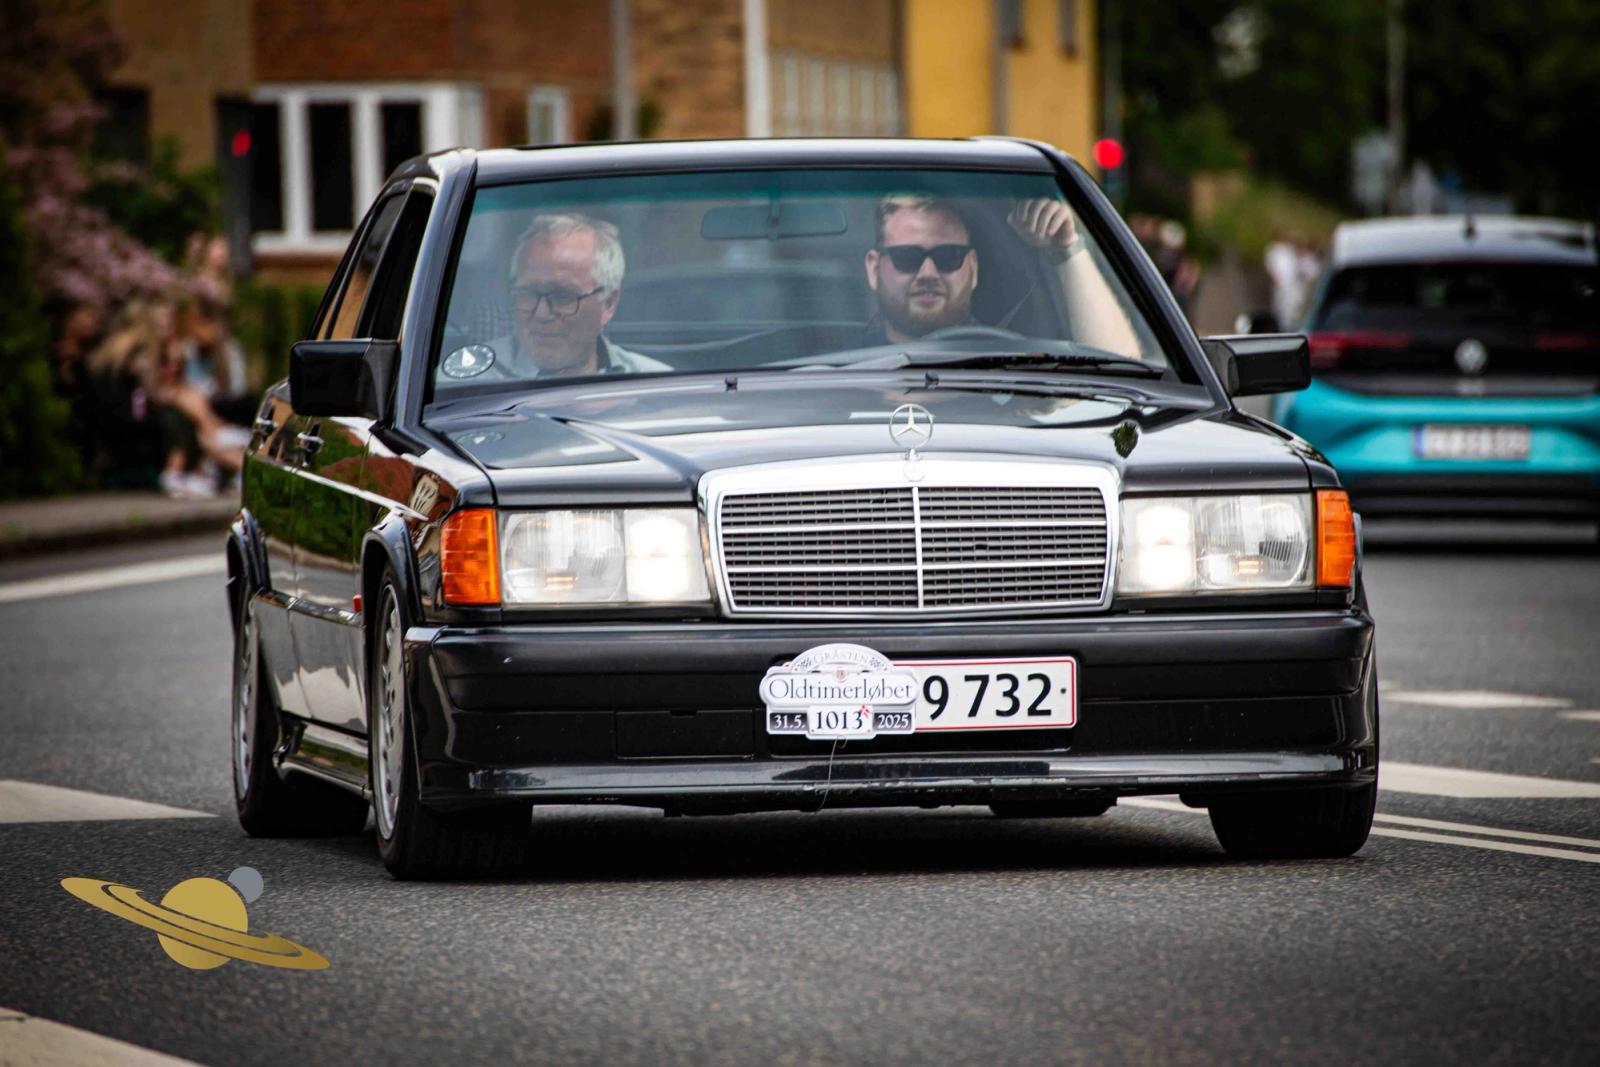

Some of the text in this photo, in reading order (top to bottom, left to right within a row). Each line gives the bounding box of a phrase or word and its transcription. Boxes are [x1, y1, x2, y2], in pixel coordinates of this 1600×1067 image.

[769, 678, 912, 701] Oldtimerløbet
[964, 673, 1053, 718] 732
[816, 710, 863, 730] 1013
[878, 714, 910, 729] 2025
